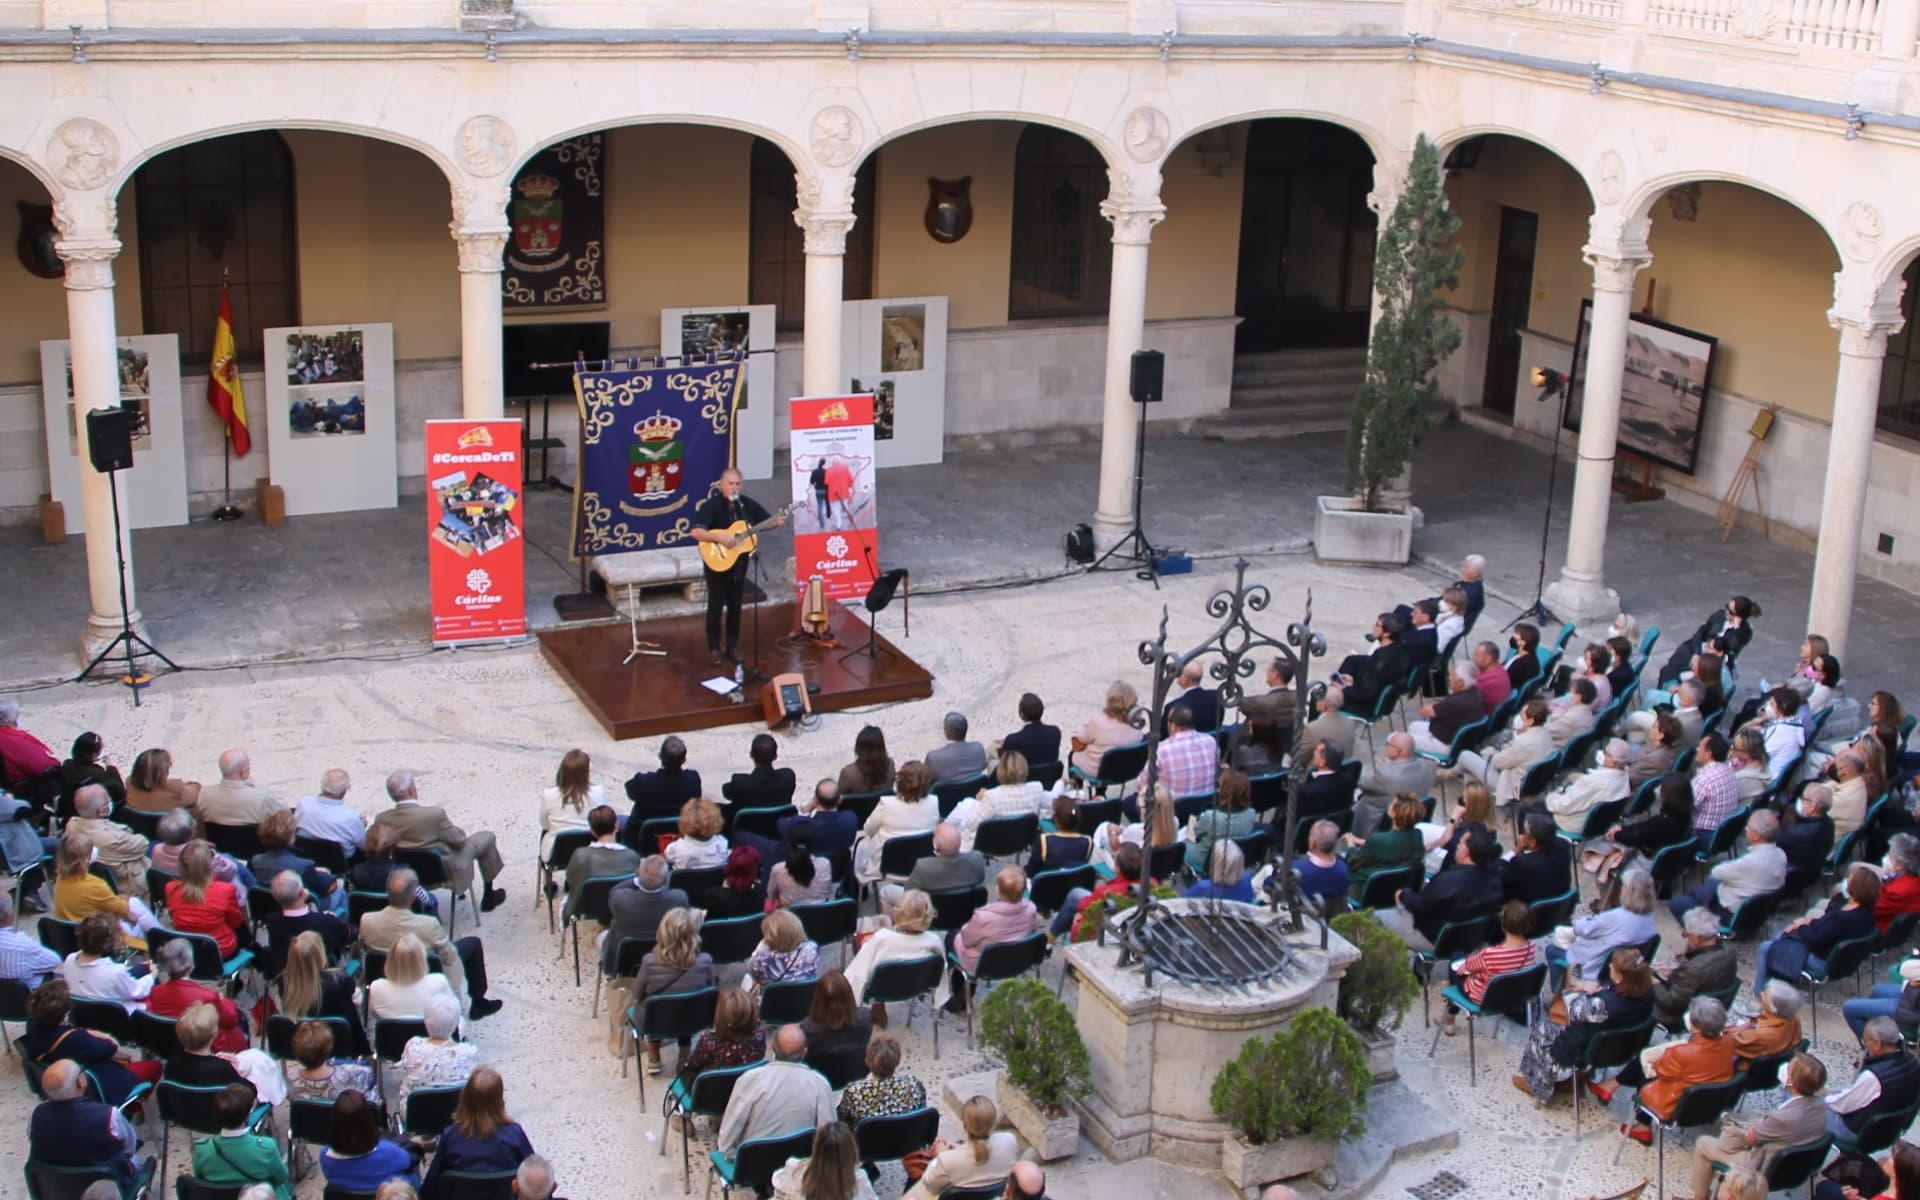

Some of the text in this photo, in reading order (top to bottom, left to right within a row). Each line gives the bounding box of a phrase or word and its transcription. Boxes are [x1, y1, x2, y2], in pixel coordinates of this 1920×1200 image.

[433, 451, 515, 464] #CercaDeTi
[816, 559, 858, 570] Cáritas
[455, 594, 502, 605] Cáritas
